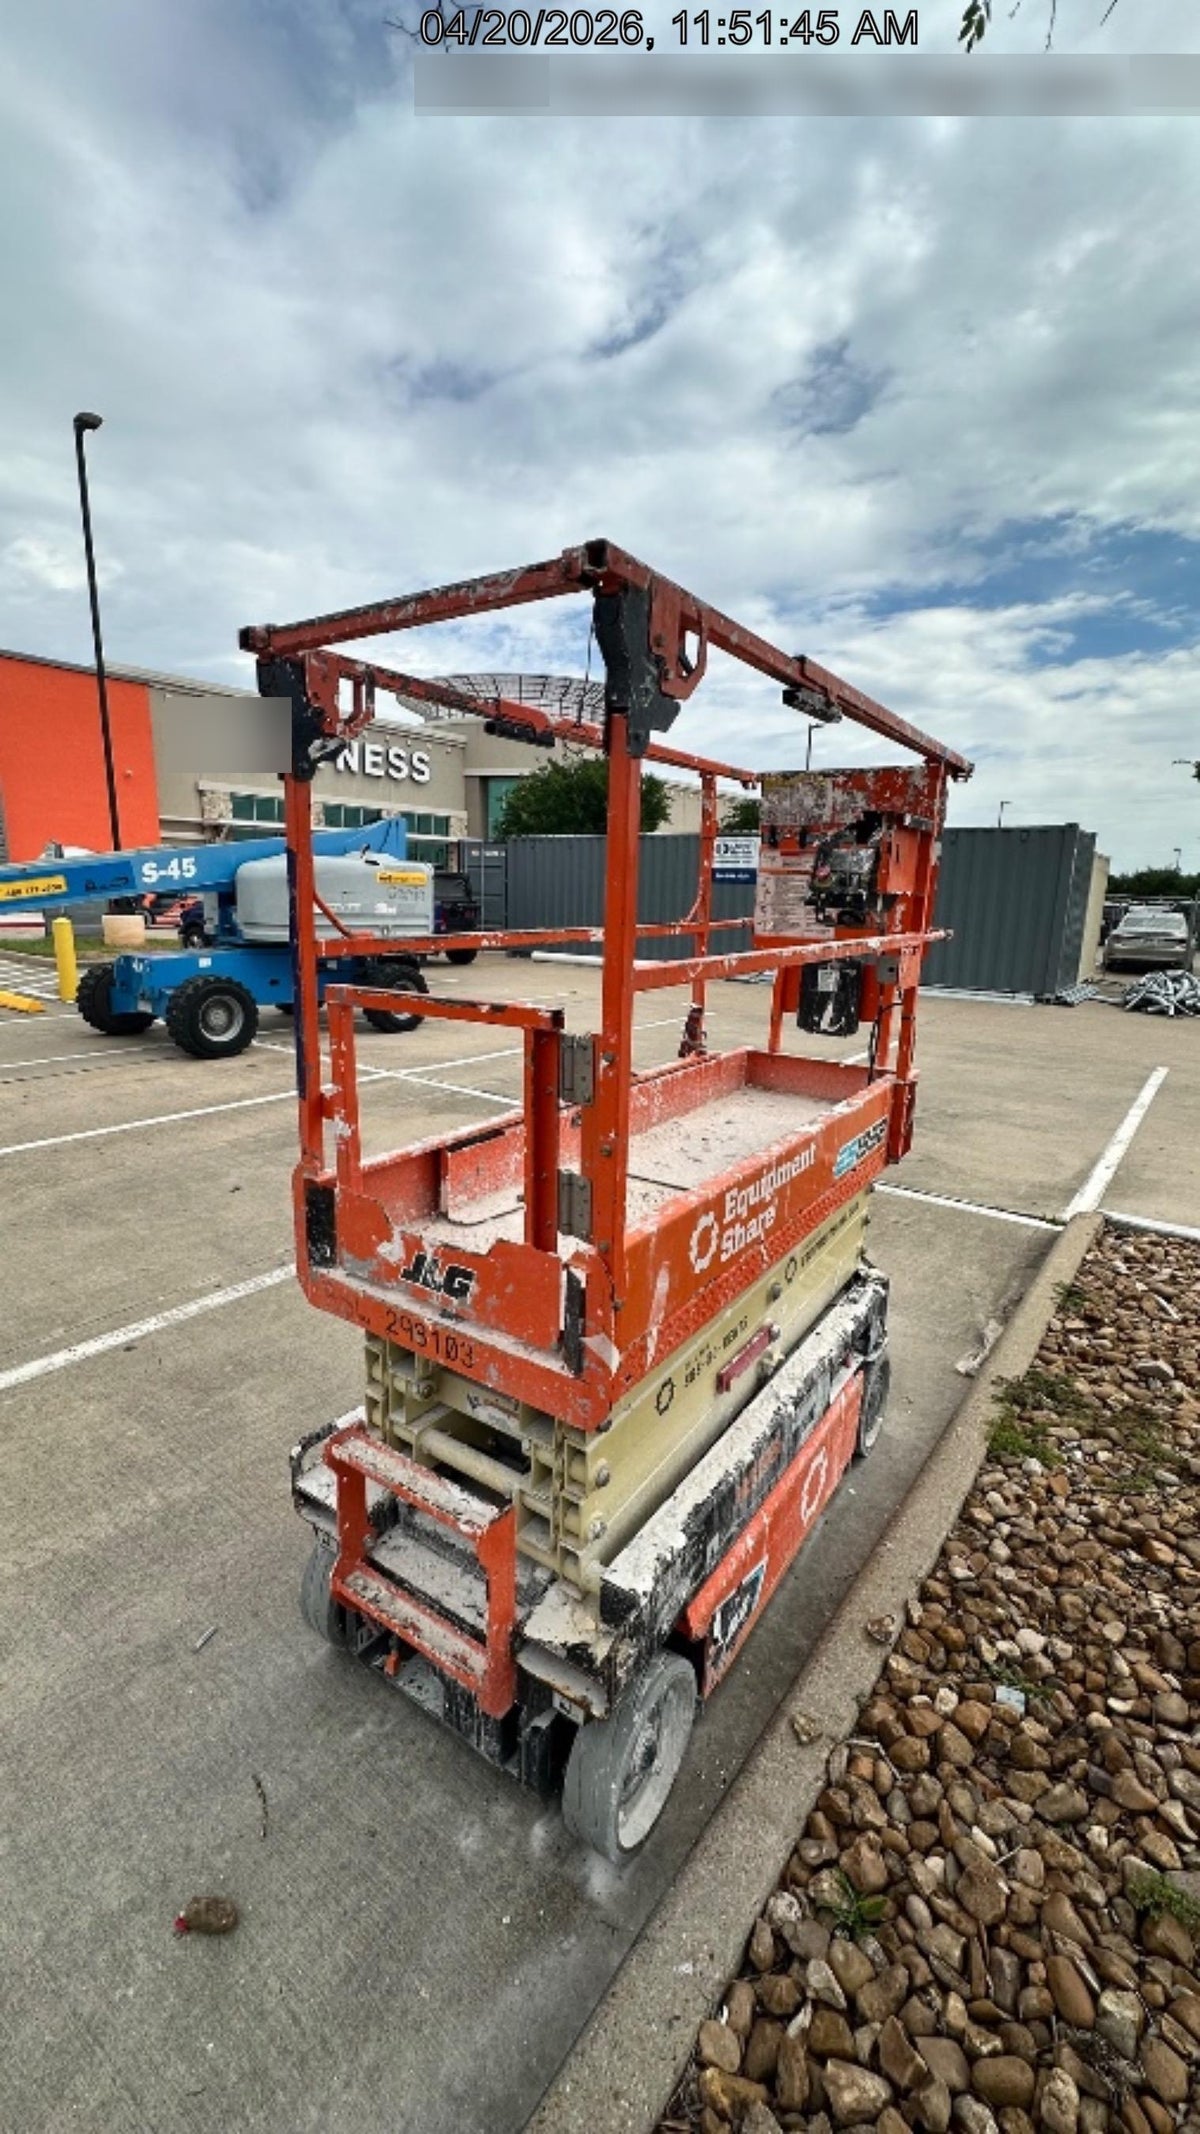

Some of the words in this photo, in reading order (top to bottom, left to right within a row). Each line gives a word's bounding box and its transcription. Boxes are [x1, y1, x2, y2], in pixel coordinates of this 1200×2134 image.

[317, 740, 430, 783] NESS
[141, 856, 197, 883] S-45
[723, 1143, 817, 1224] Equipment
[720, 1206, 777, 1262] Share
